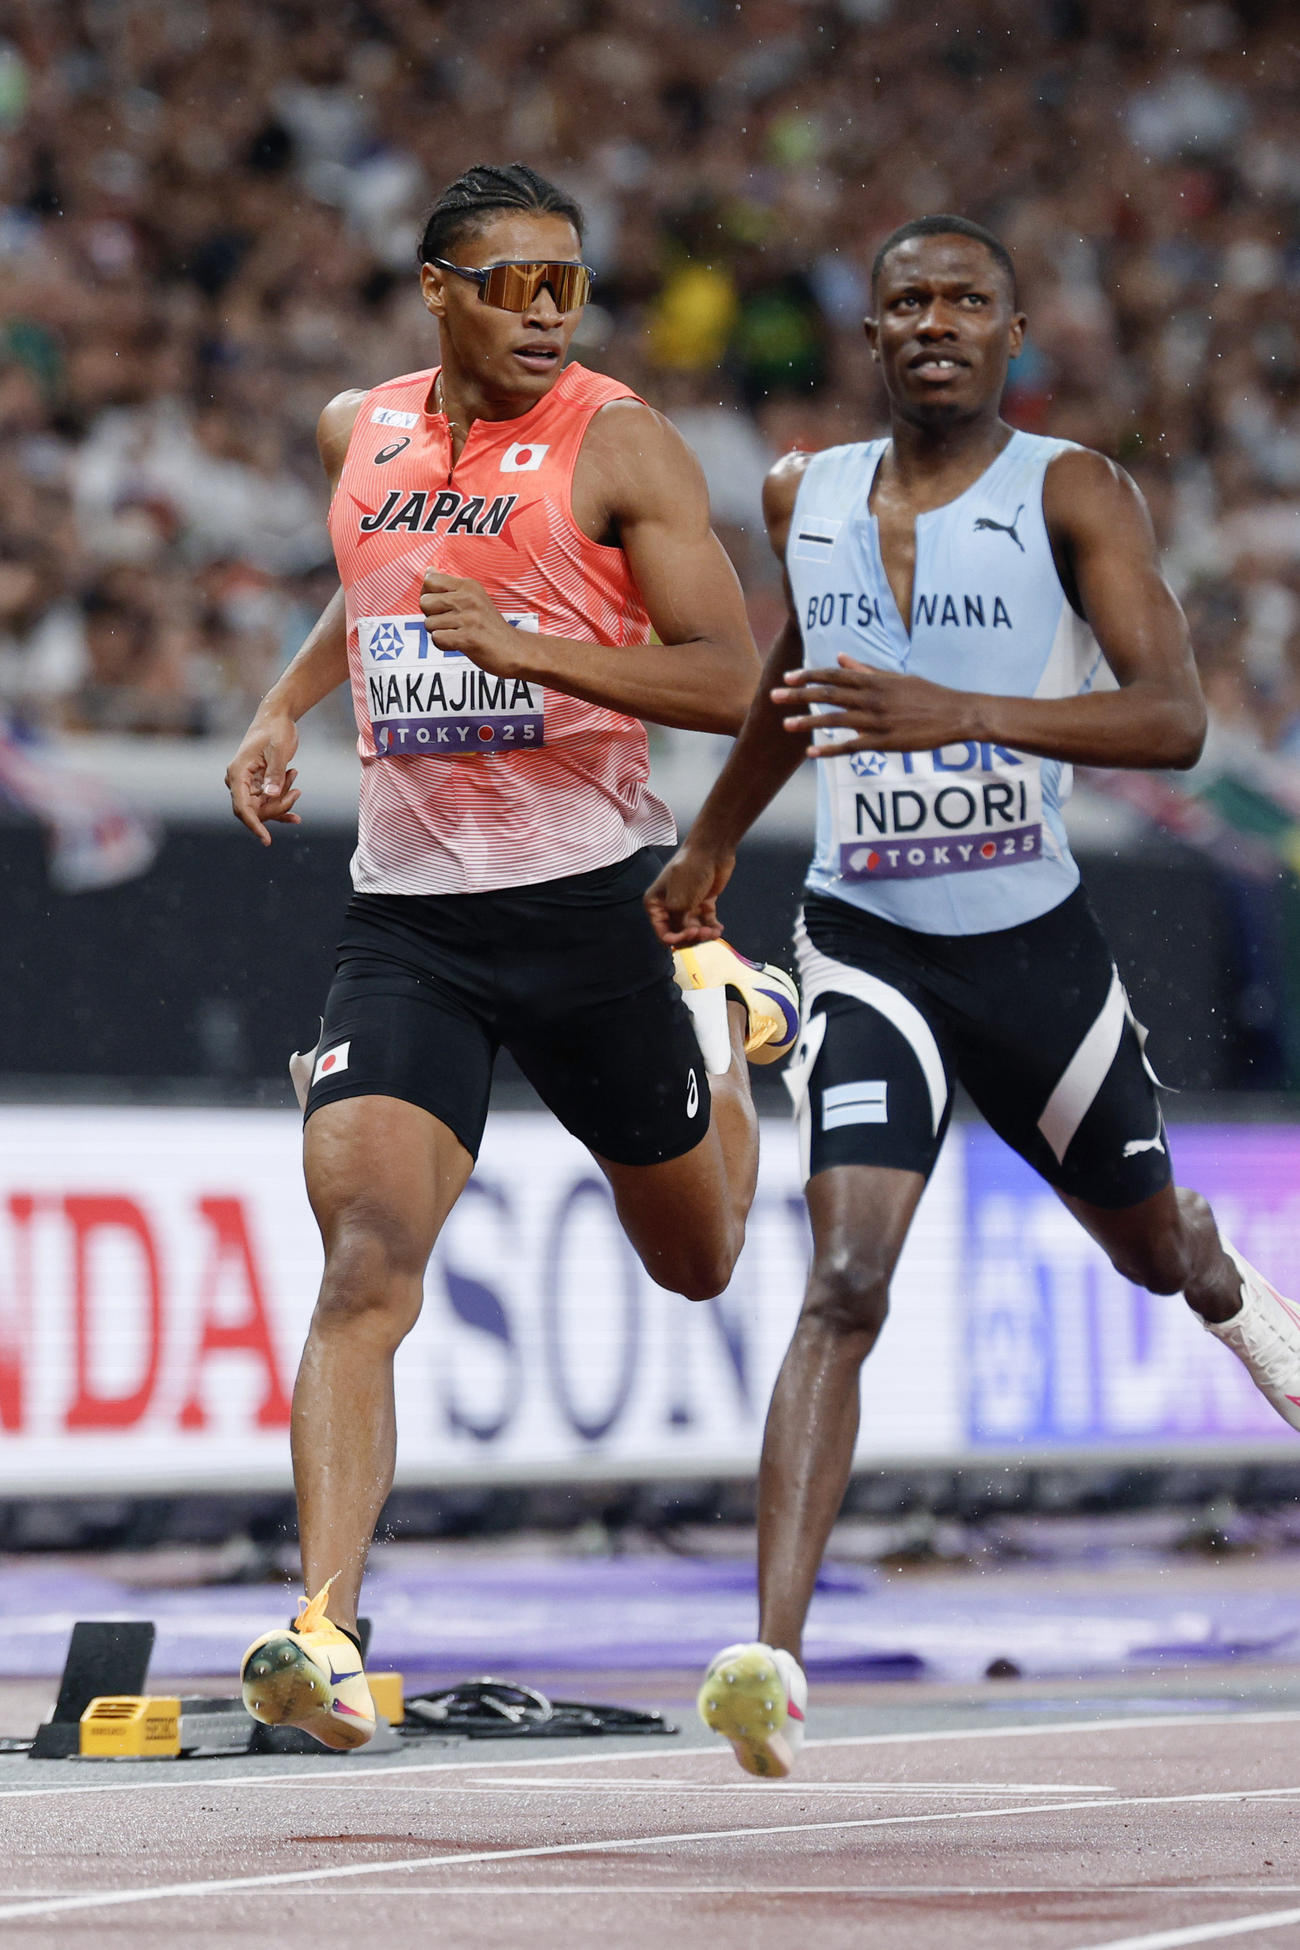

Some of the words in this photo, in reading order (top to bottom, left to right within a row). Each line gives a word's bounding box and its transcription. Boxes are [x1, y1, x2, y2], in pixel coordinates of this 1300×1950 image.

[360, 489, 519, 536] JAPAN
[369, 670, 534, 716] NAKAJIMA
[855, 780, 1027, 835] NDORI
[437, 1176, 814, 1441] SON
